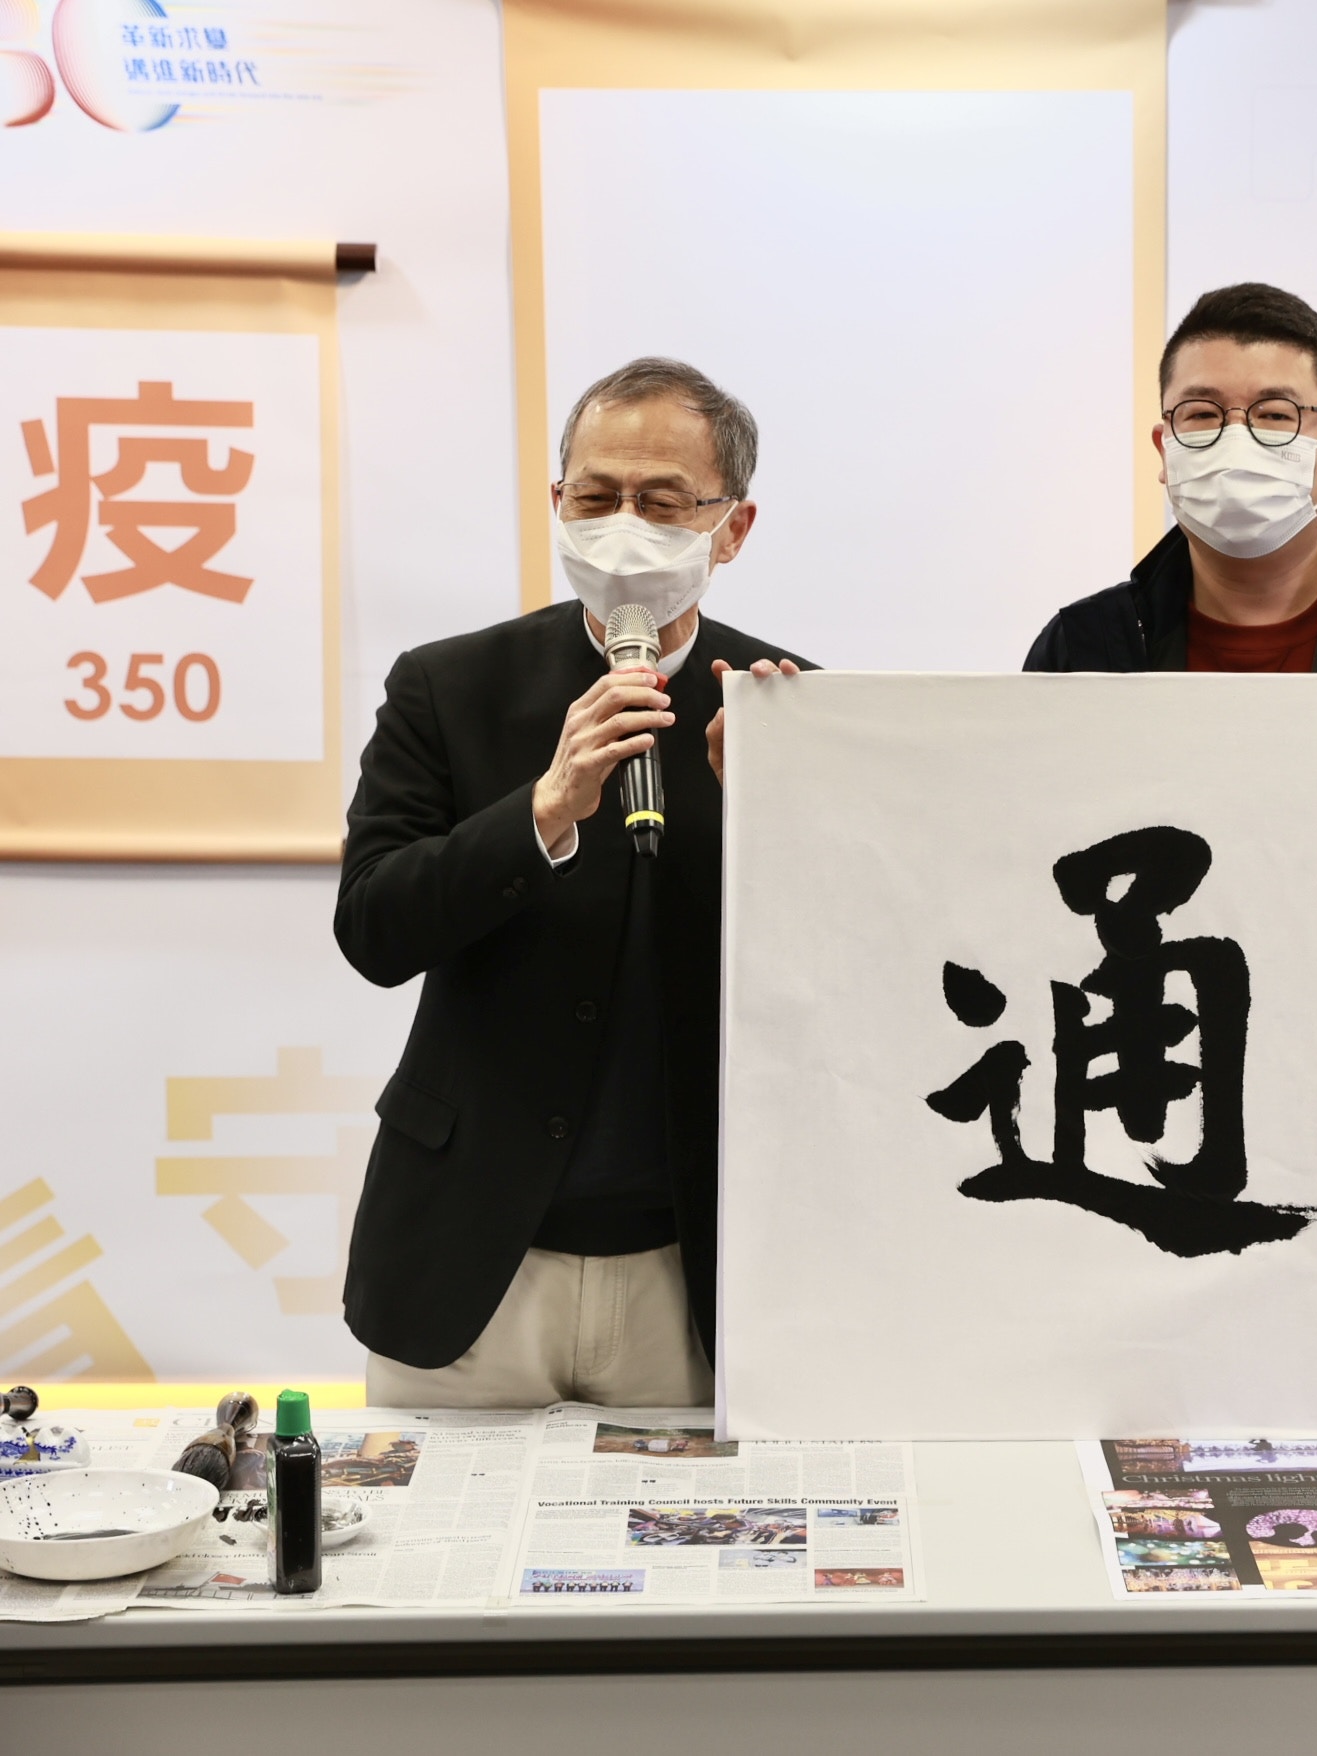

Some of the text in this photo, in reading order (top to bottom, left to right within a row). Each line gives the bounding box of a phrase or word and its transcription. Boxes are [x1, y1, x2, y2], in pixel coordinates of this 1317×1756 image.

[20, 380, 256, 605] 疫
[63, 650, 221, 723] 350
[1121, 1473, 1262, 1483] Christmas
[537, 1499, 597, 1508] Vocational
[600, 1498, 645, 1506] Training
[648, 1498, 690, 1506] Council
[800, 1497, 864, 1506] Community
[866, 1498, 898, 1506] Event
